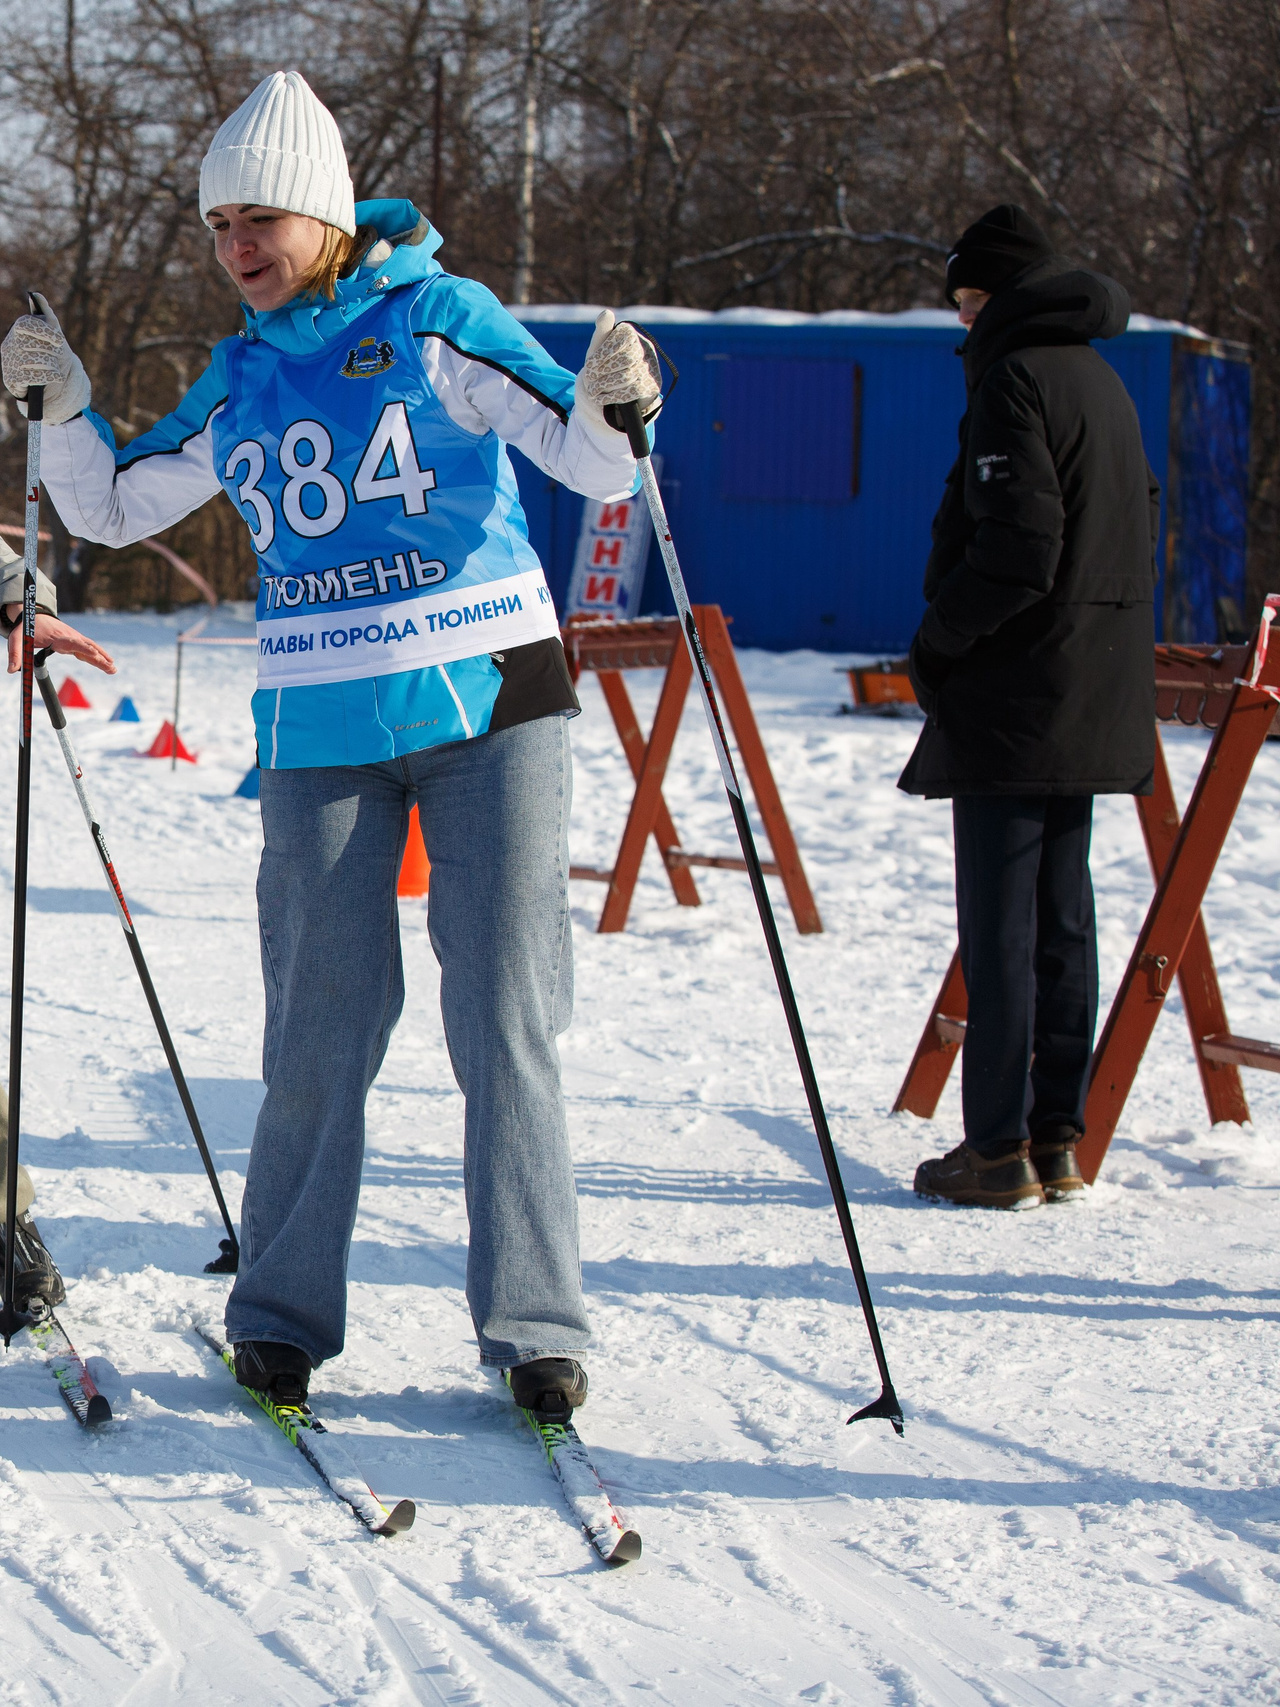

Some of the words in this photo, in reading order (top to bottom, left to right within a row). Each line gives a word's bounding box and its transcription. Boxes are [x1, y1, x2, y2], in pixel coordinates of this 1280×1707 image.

[225, 401, 437, 553] 384
[28, 584, 36, 597] 30
[264, 549, 447, 611] ТЮМЕНЬ
[260, 633, 314, 656] ГЛАВЫ
[321, 618, 419, 649] ГОРОДА
[425, 594, 523, 632] ТЮМЕНИ
